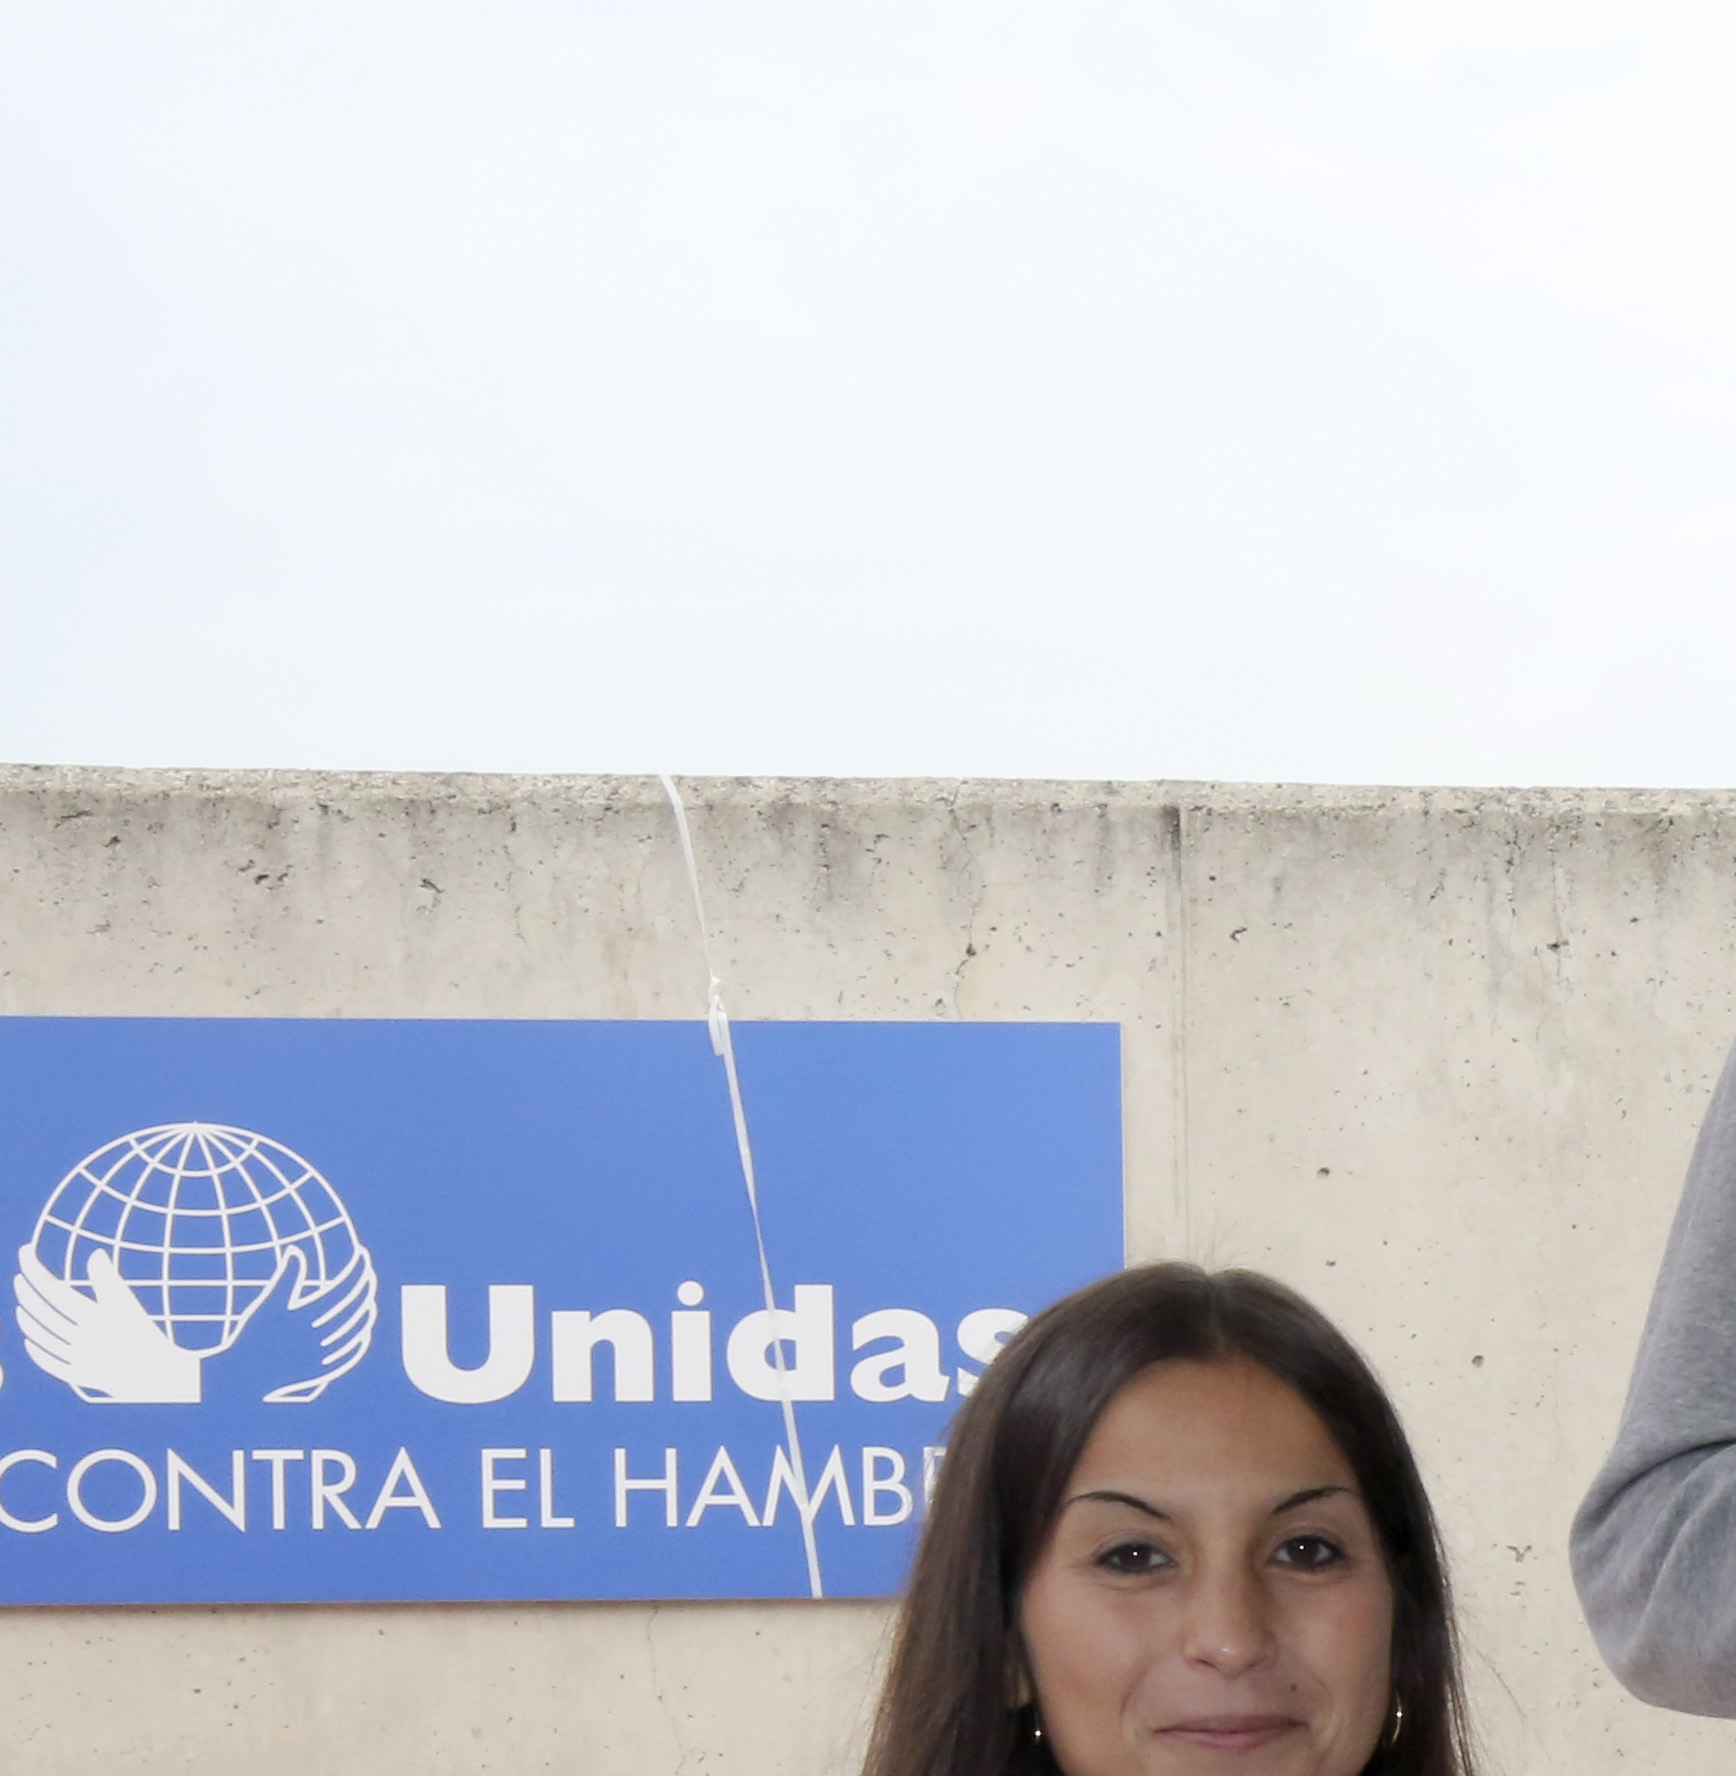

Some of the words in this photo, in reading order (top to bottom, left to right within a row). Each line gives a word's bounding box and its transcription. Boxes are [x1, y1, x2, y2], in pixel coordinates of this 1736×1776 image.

[401, 1280, 1029, 1403] Unidas
[0, 1446, 442, 1532] CONTRA
[481, 1448, 575, 1529] EL
